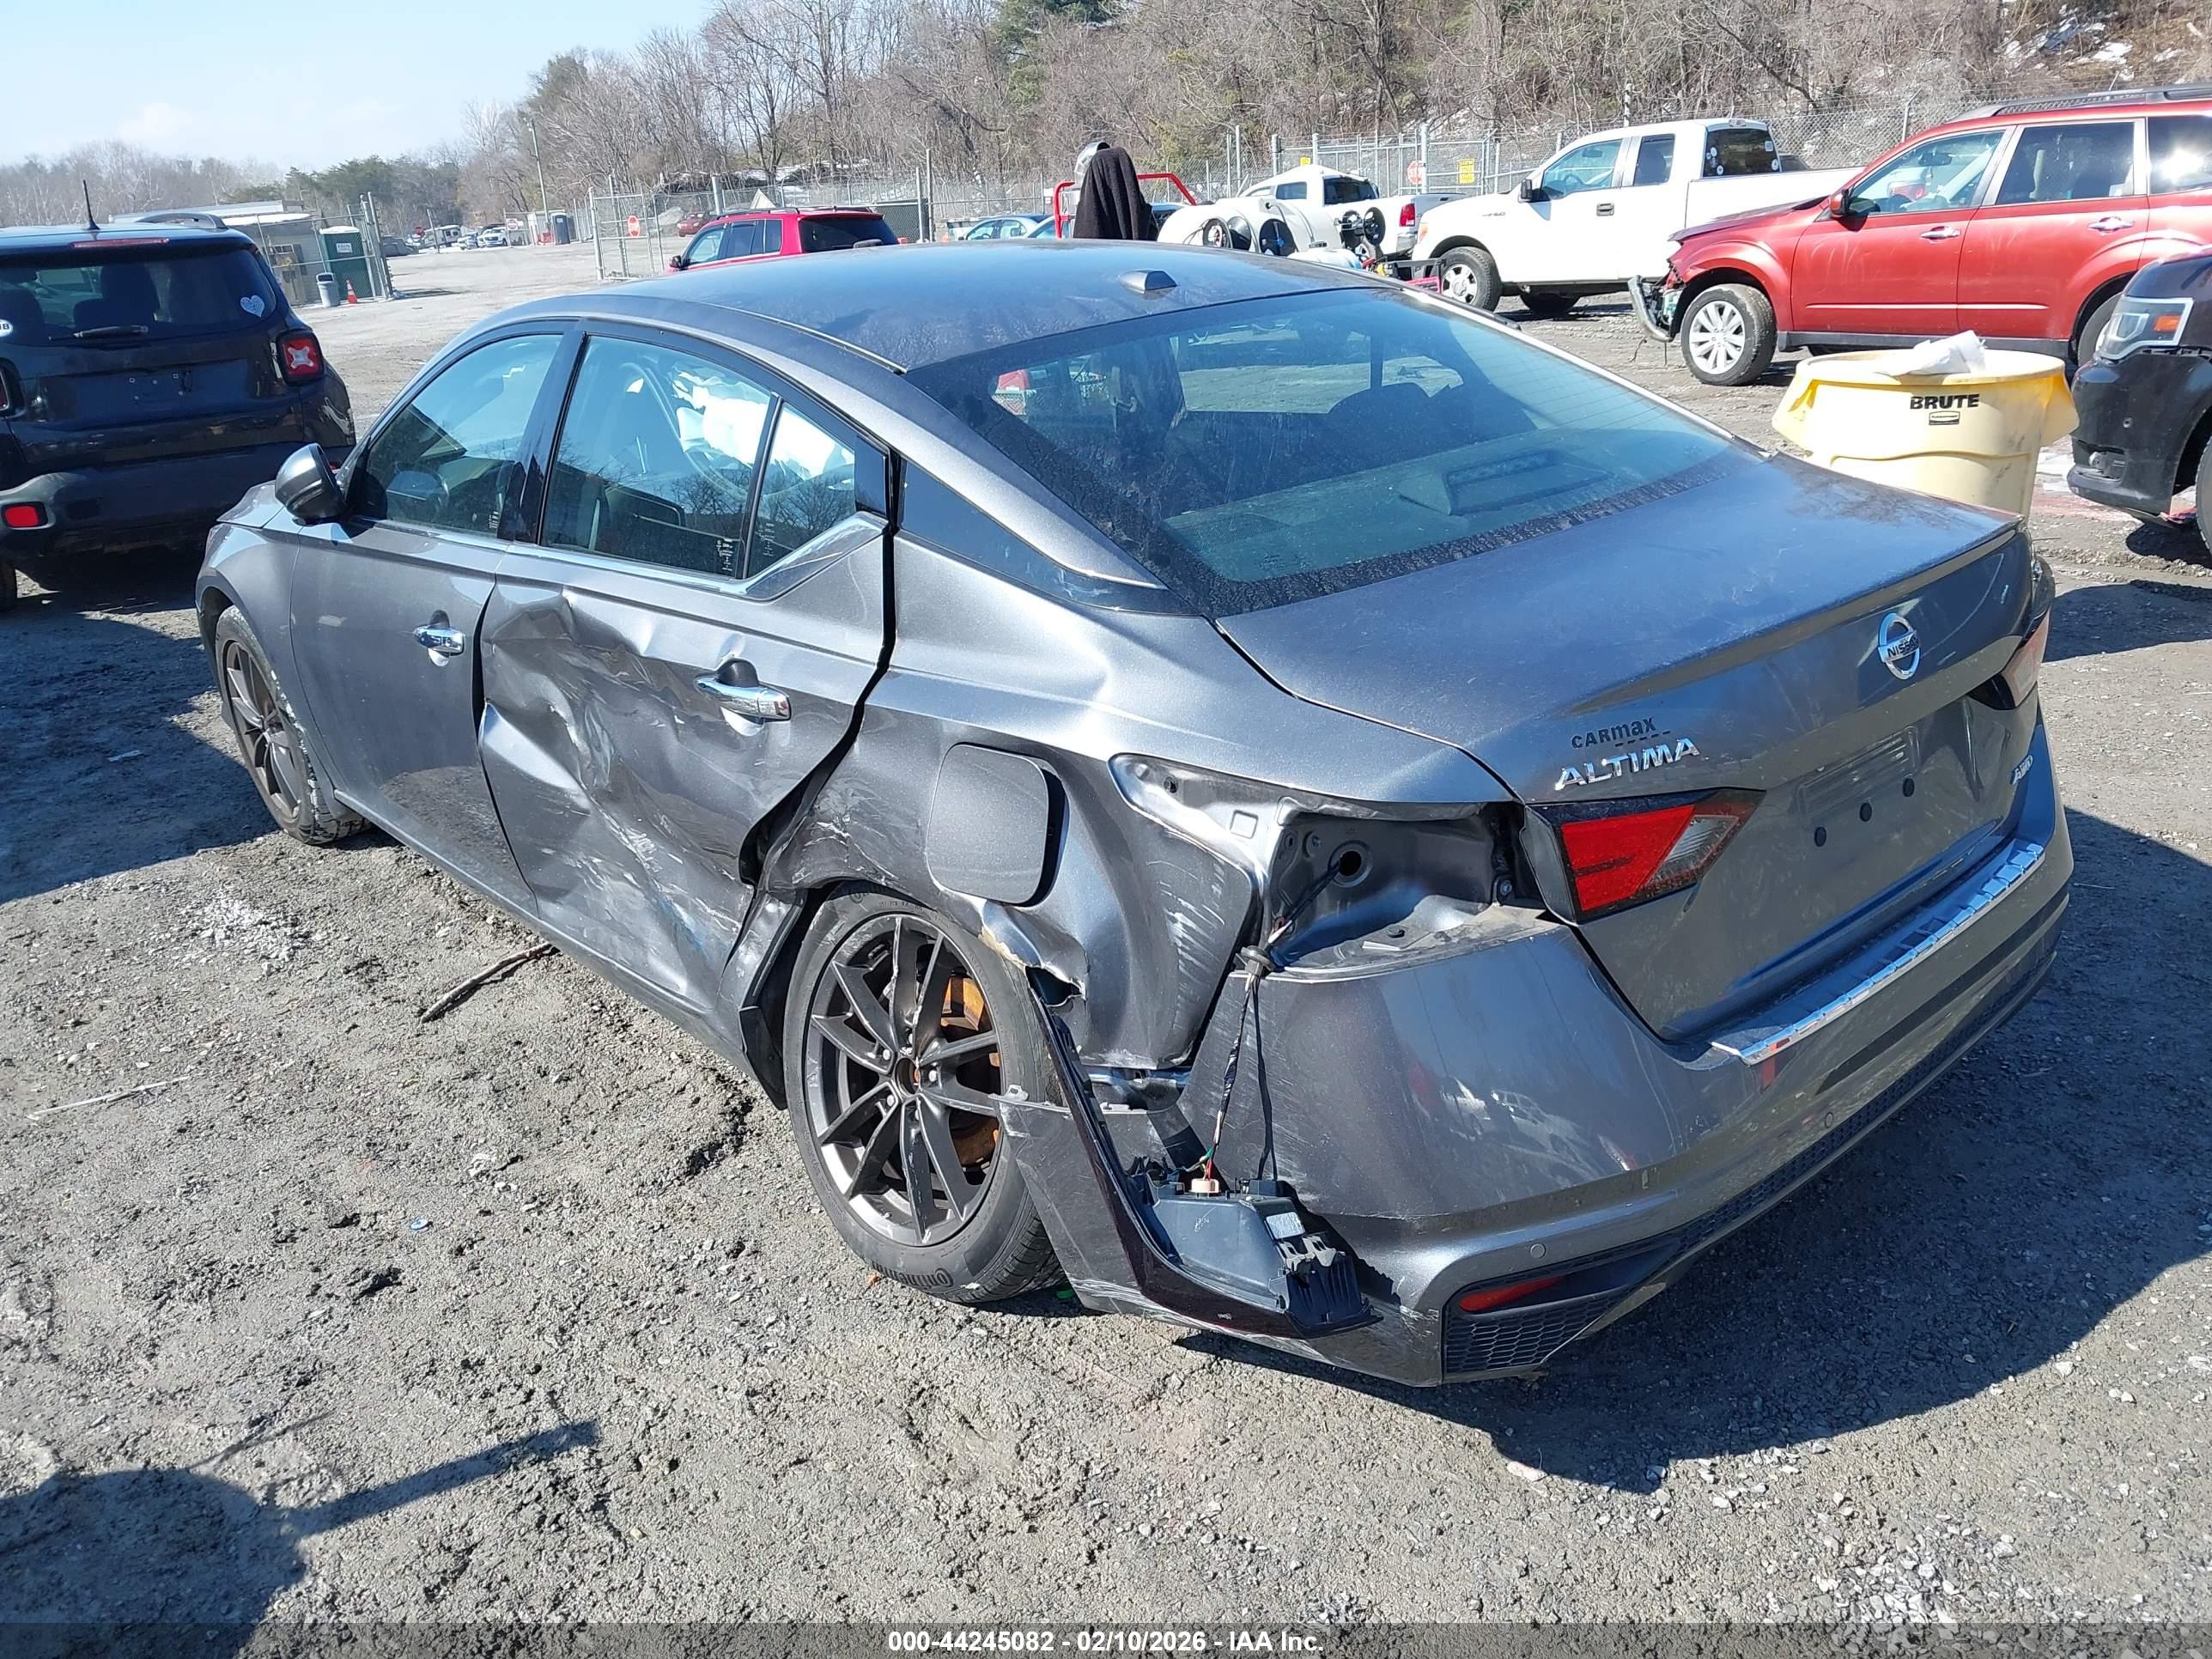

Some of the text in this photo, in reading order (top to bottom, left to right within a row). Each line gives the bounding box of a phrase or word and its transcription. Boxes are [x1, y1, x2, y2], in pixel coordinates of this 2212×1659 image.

[1910, 394, 1979, 409] BRUTE
[1887, 635, 1918, 658] NISSAN
[1554, 737, 1700, 791] ALTIMA
[2011, 755, 2033, 784] AWD
